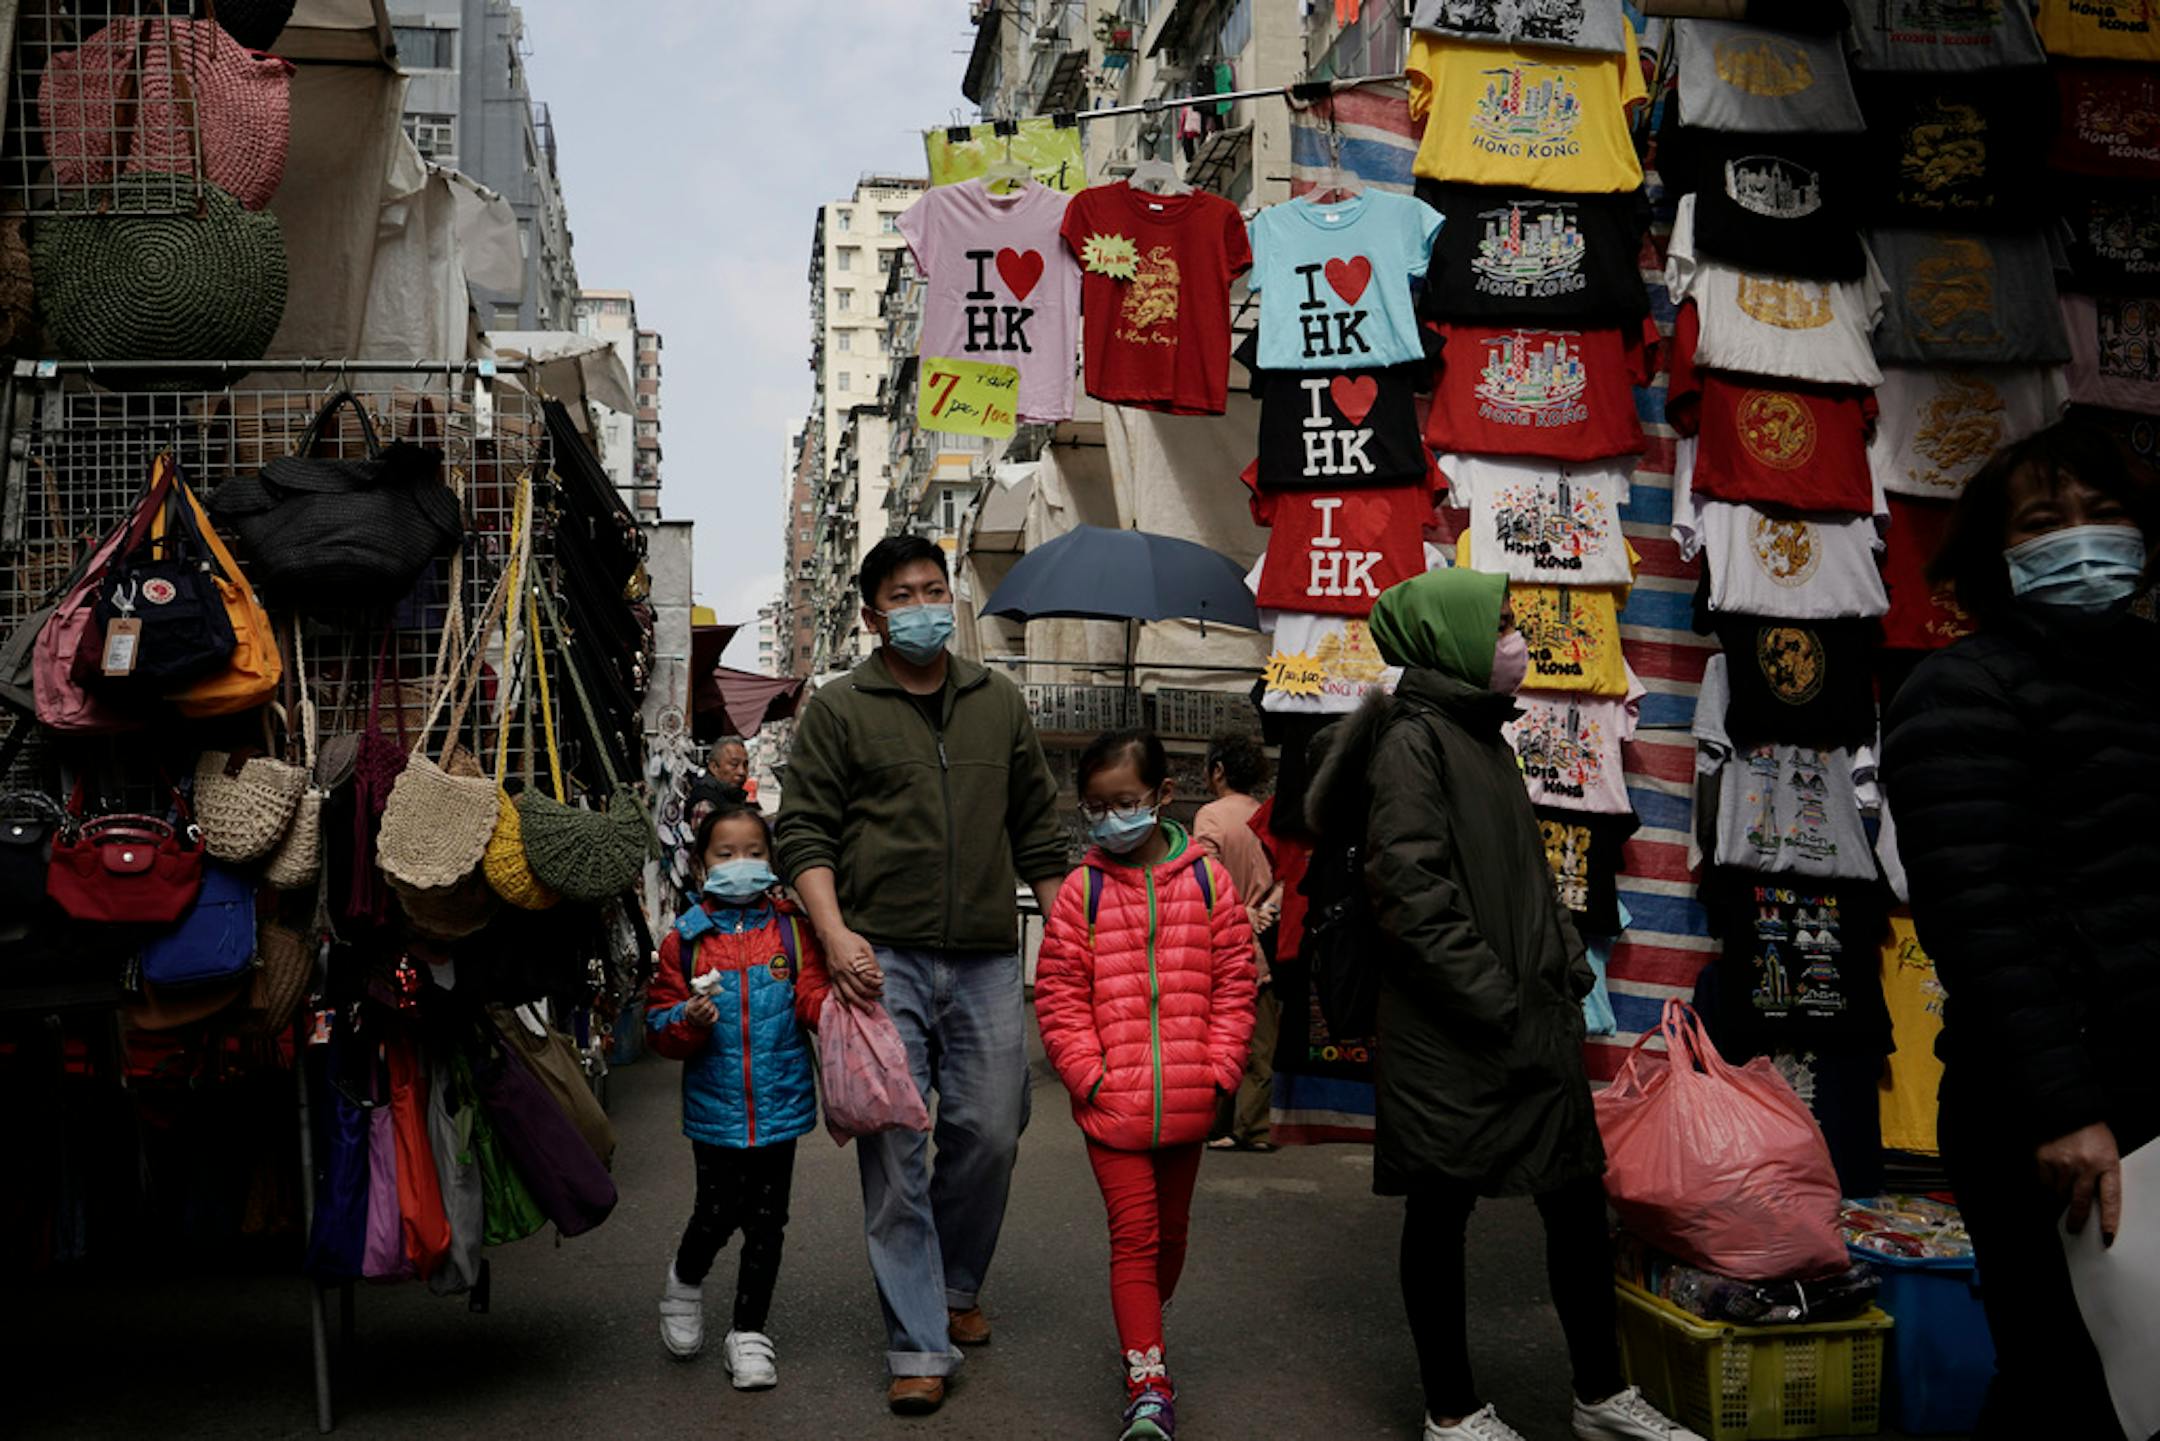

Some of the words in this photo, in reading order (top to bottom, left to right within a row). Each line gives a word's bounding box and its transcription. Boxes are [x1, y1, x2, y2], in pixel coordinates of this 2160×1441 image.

[2069, 1, 2116, 17] HONG
[2099, 19, 2149, 33] KONG
[2078, 128, 2130, 145] HONG
[1471, 135, 1521, 158] HONG
[1526, 140, 1580, 159] KONG
[2107, 145, 2160, 161] KONG
[2095, 246, 2145, 260] HONG
[966, 250, 995, 300] I
[2124, 260, 2160, 275] KON
[1296, 265, 1325, 309] I
[1474, 274, 1527, 298] HONG
[1530, 272, 1589, 298] KONG
[964, 305, 1034, 353] HK
[1300, 310, 1372, 358] HK
[928, 371, 961, 417] 7
[1300, 378, 1333, 428] I
[1477, 402, 1531, 426] HONG
[1534, 403, 1589, 428] KONG
[1301, 427, 1376, 477] HK
[1311, 497, 1344, 548] I
[1504, 540, 1552, 554] HONG
[1535, 555, 1582, 569] KONG
[1306, 550, 1384, 598] HK
[1529, 648, 1552, 660] NG
[1536, 662, 1583, 676] KONG
[1544, 780, 1584, 798] KONG
[1753, 885, 1797, 905] HONG
[1308, 1044, 1369, 1063] HONG
